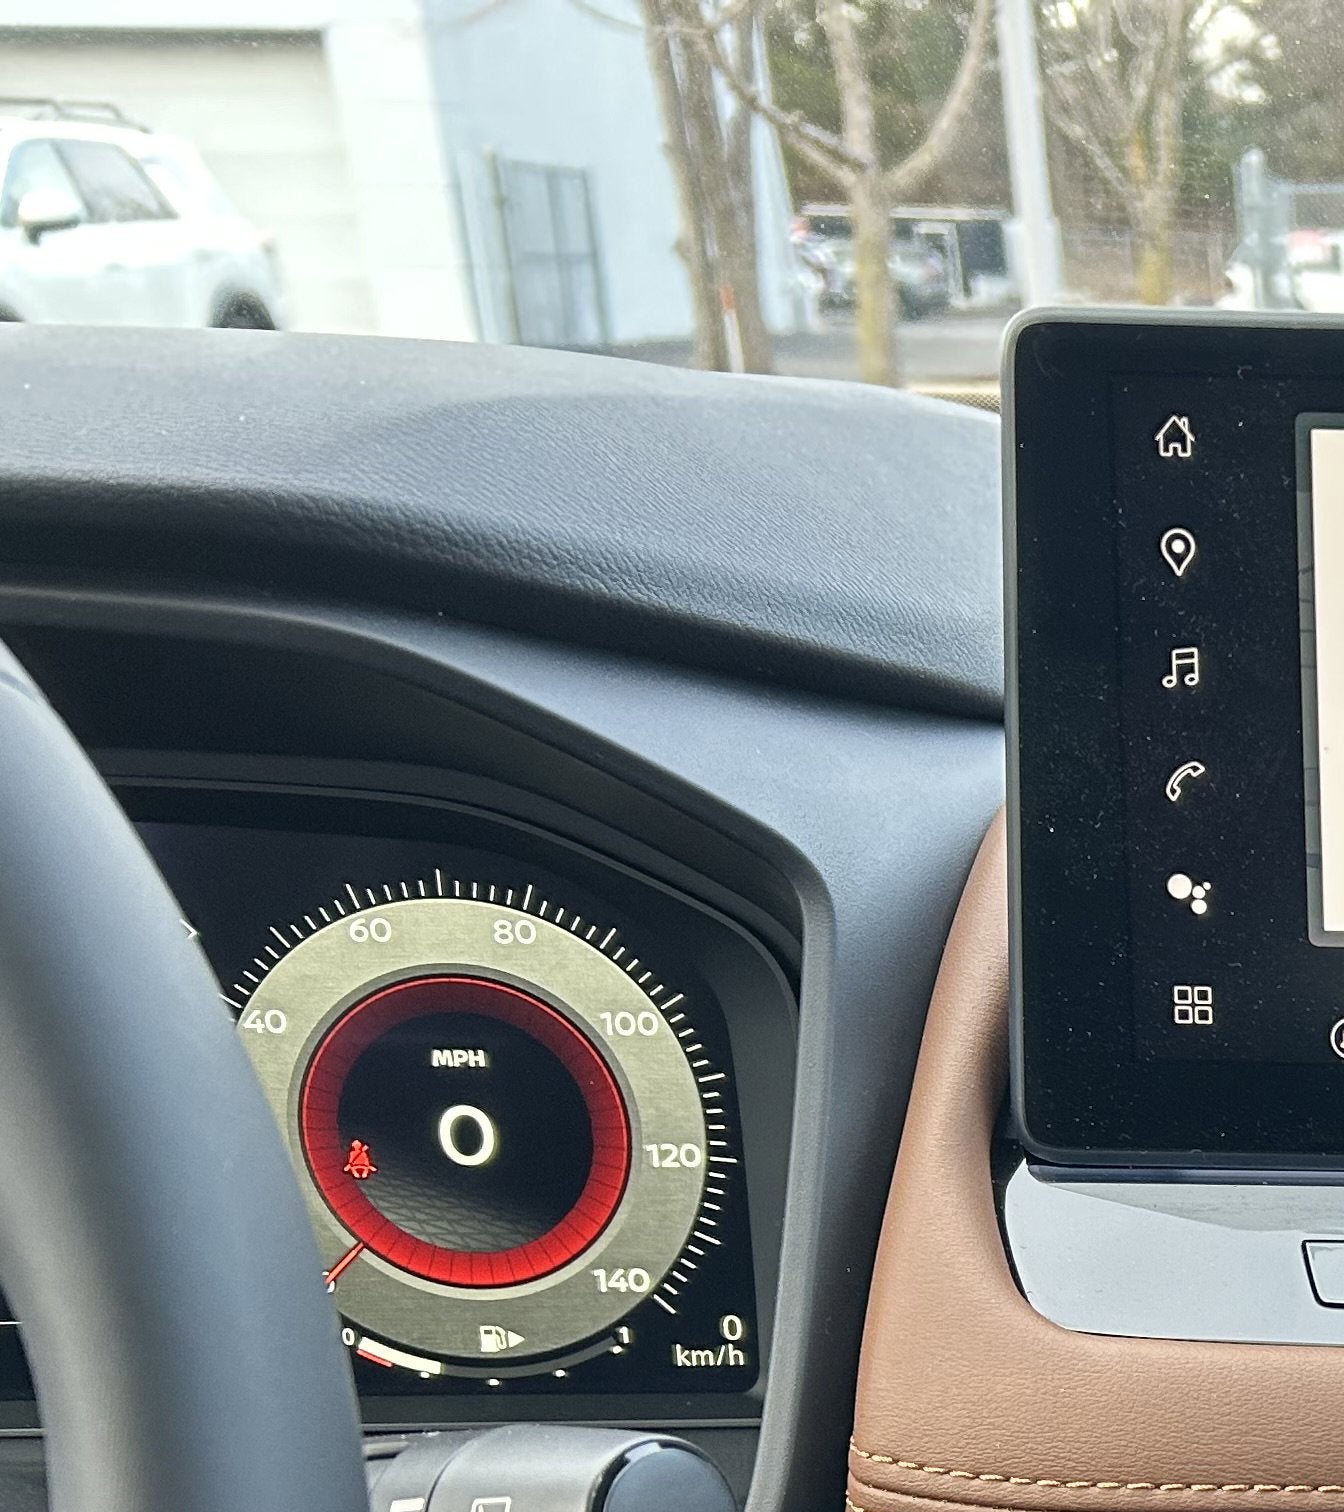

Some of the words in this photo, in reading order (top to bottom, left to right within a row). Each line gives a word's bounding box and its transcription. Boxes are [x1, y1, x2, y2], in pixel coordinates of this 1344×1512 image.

[348, 916, 393, 944] 60
[494, 917, 539, 945] 80
[242, 1009, 288, 1034] 40
[599, 1010, 660, 1038] 100
[431, 1049, 486, 1068] MPH
[439, 1105, 496, 1166] 0
[643, 1143, 703, 1169] 120
[593, 1268, 651, 1295] 140
[722, 1314, 744, 1341] 0
[675, 1343, 745, 1367] km/h
